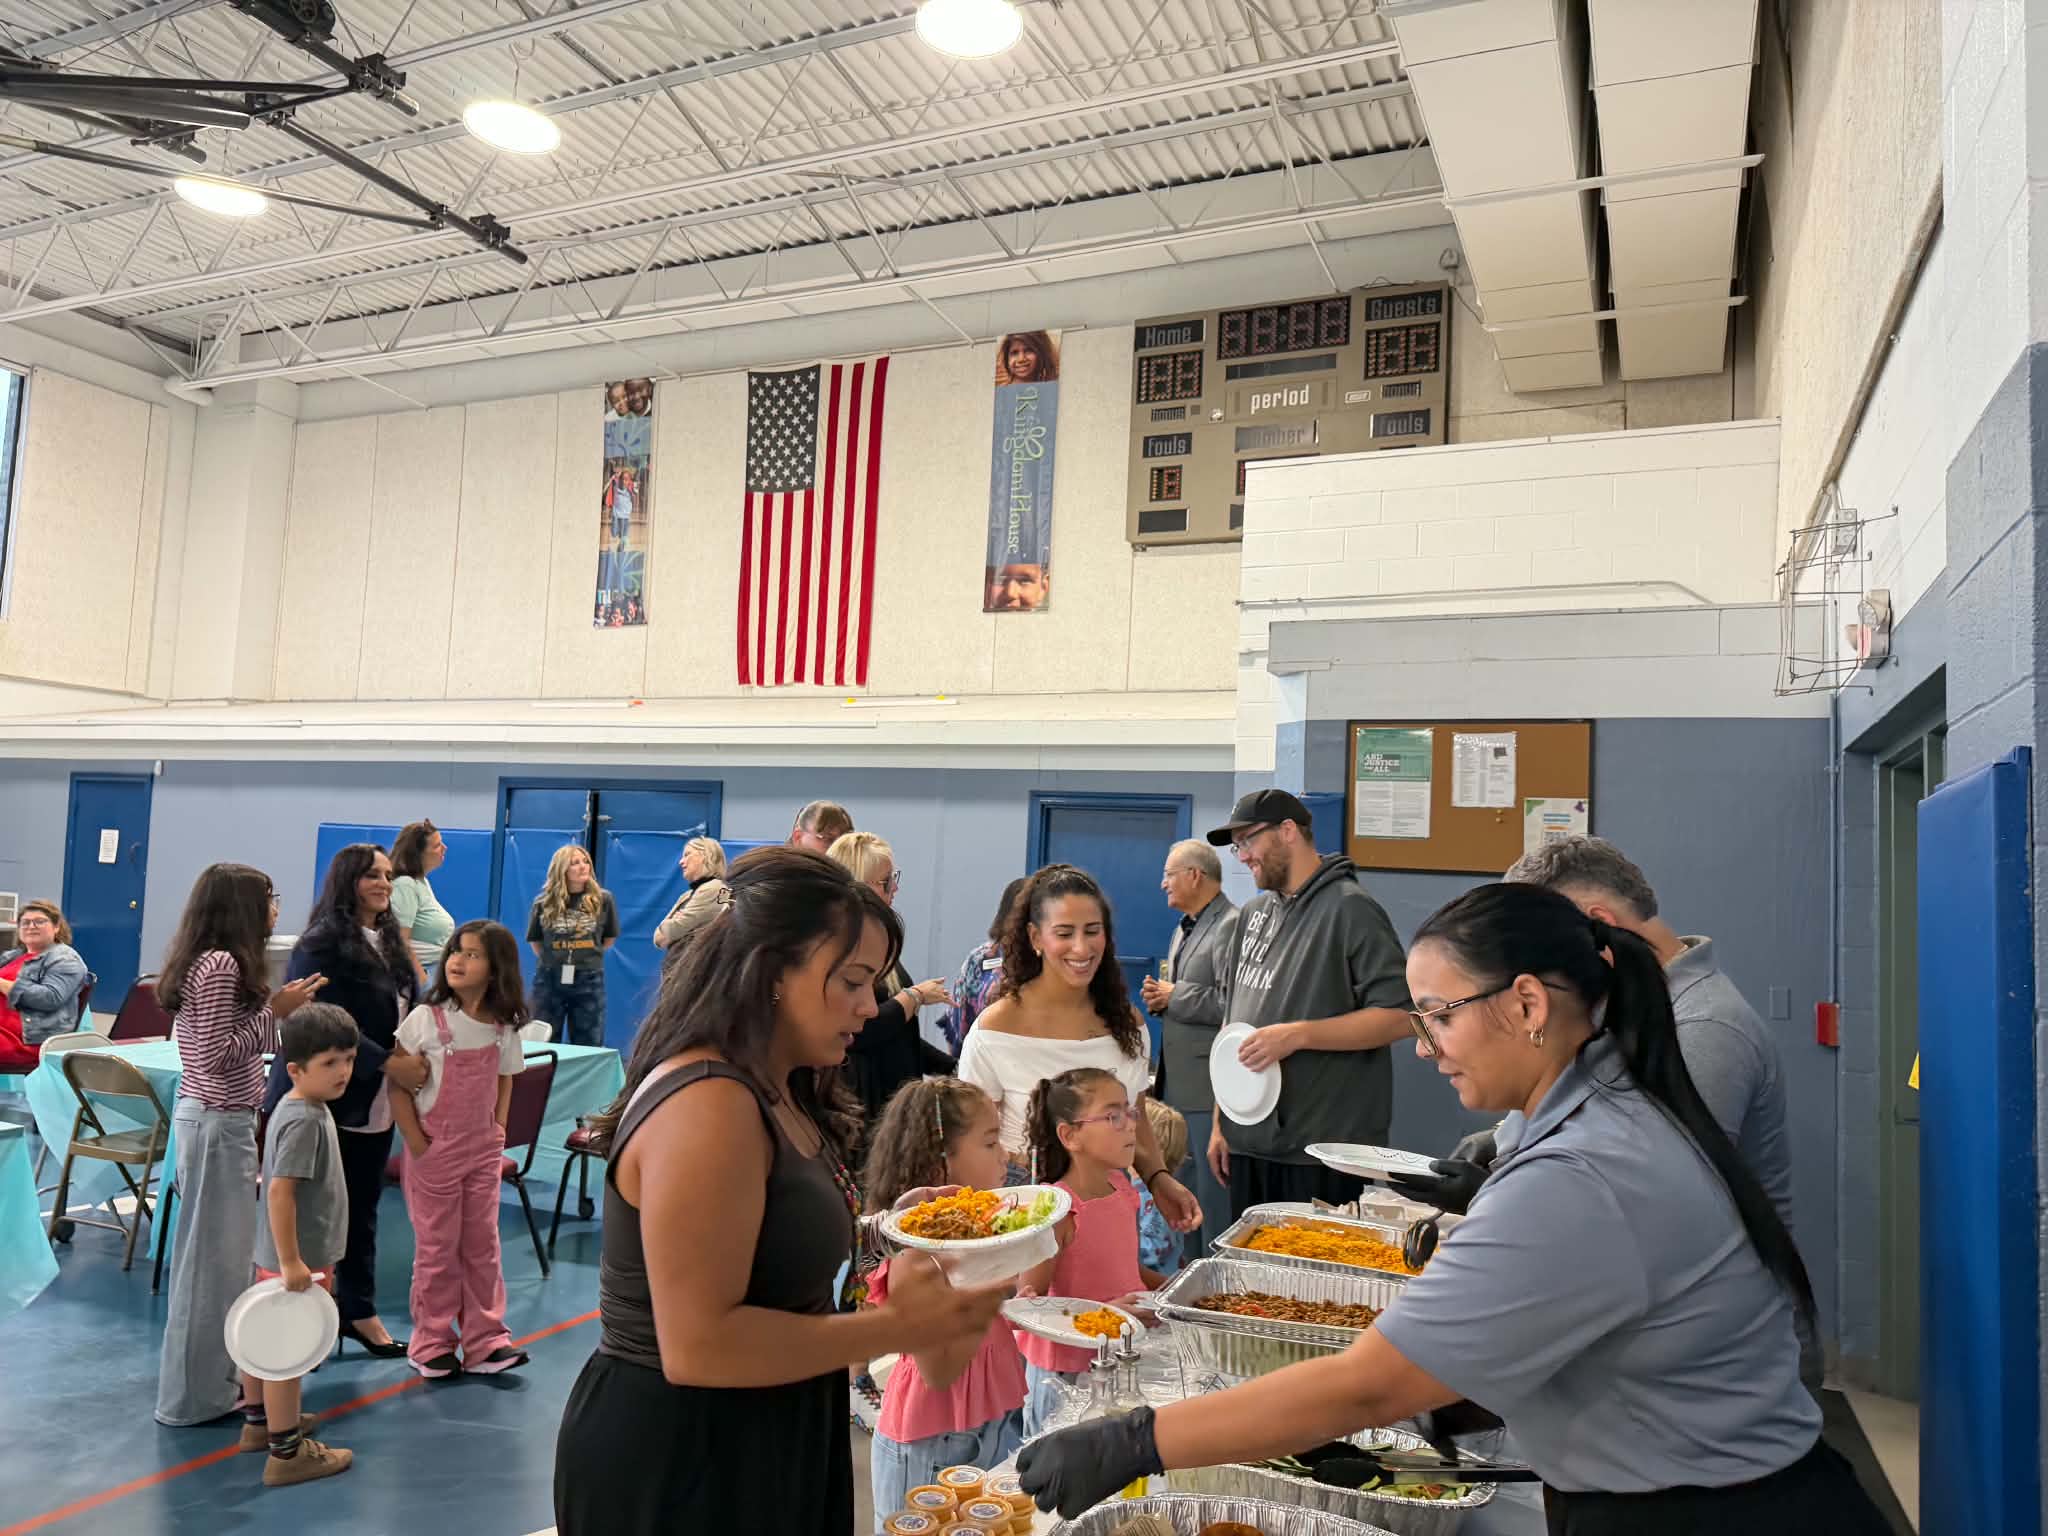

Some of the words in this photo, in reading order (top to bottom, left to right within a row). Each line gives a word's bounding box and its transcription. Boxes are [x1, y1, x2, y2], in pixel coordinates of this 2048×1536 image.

[1145, 326, 1192, 348] Home
[1250, 383, 1310, 415] period
[1248, 911, 1268, 933] BE
